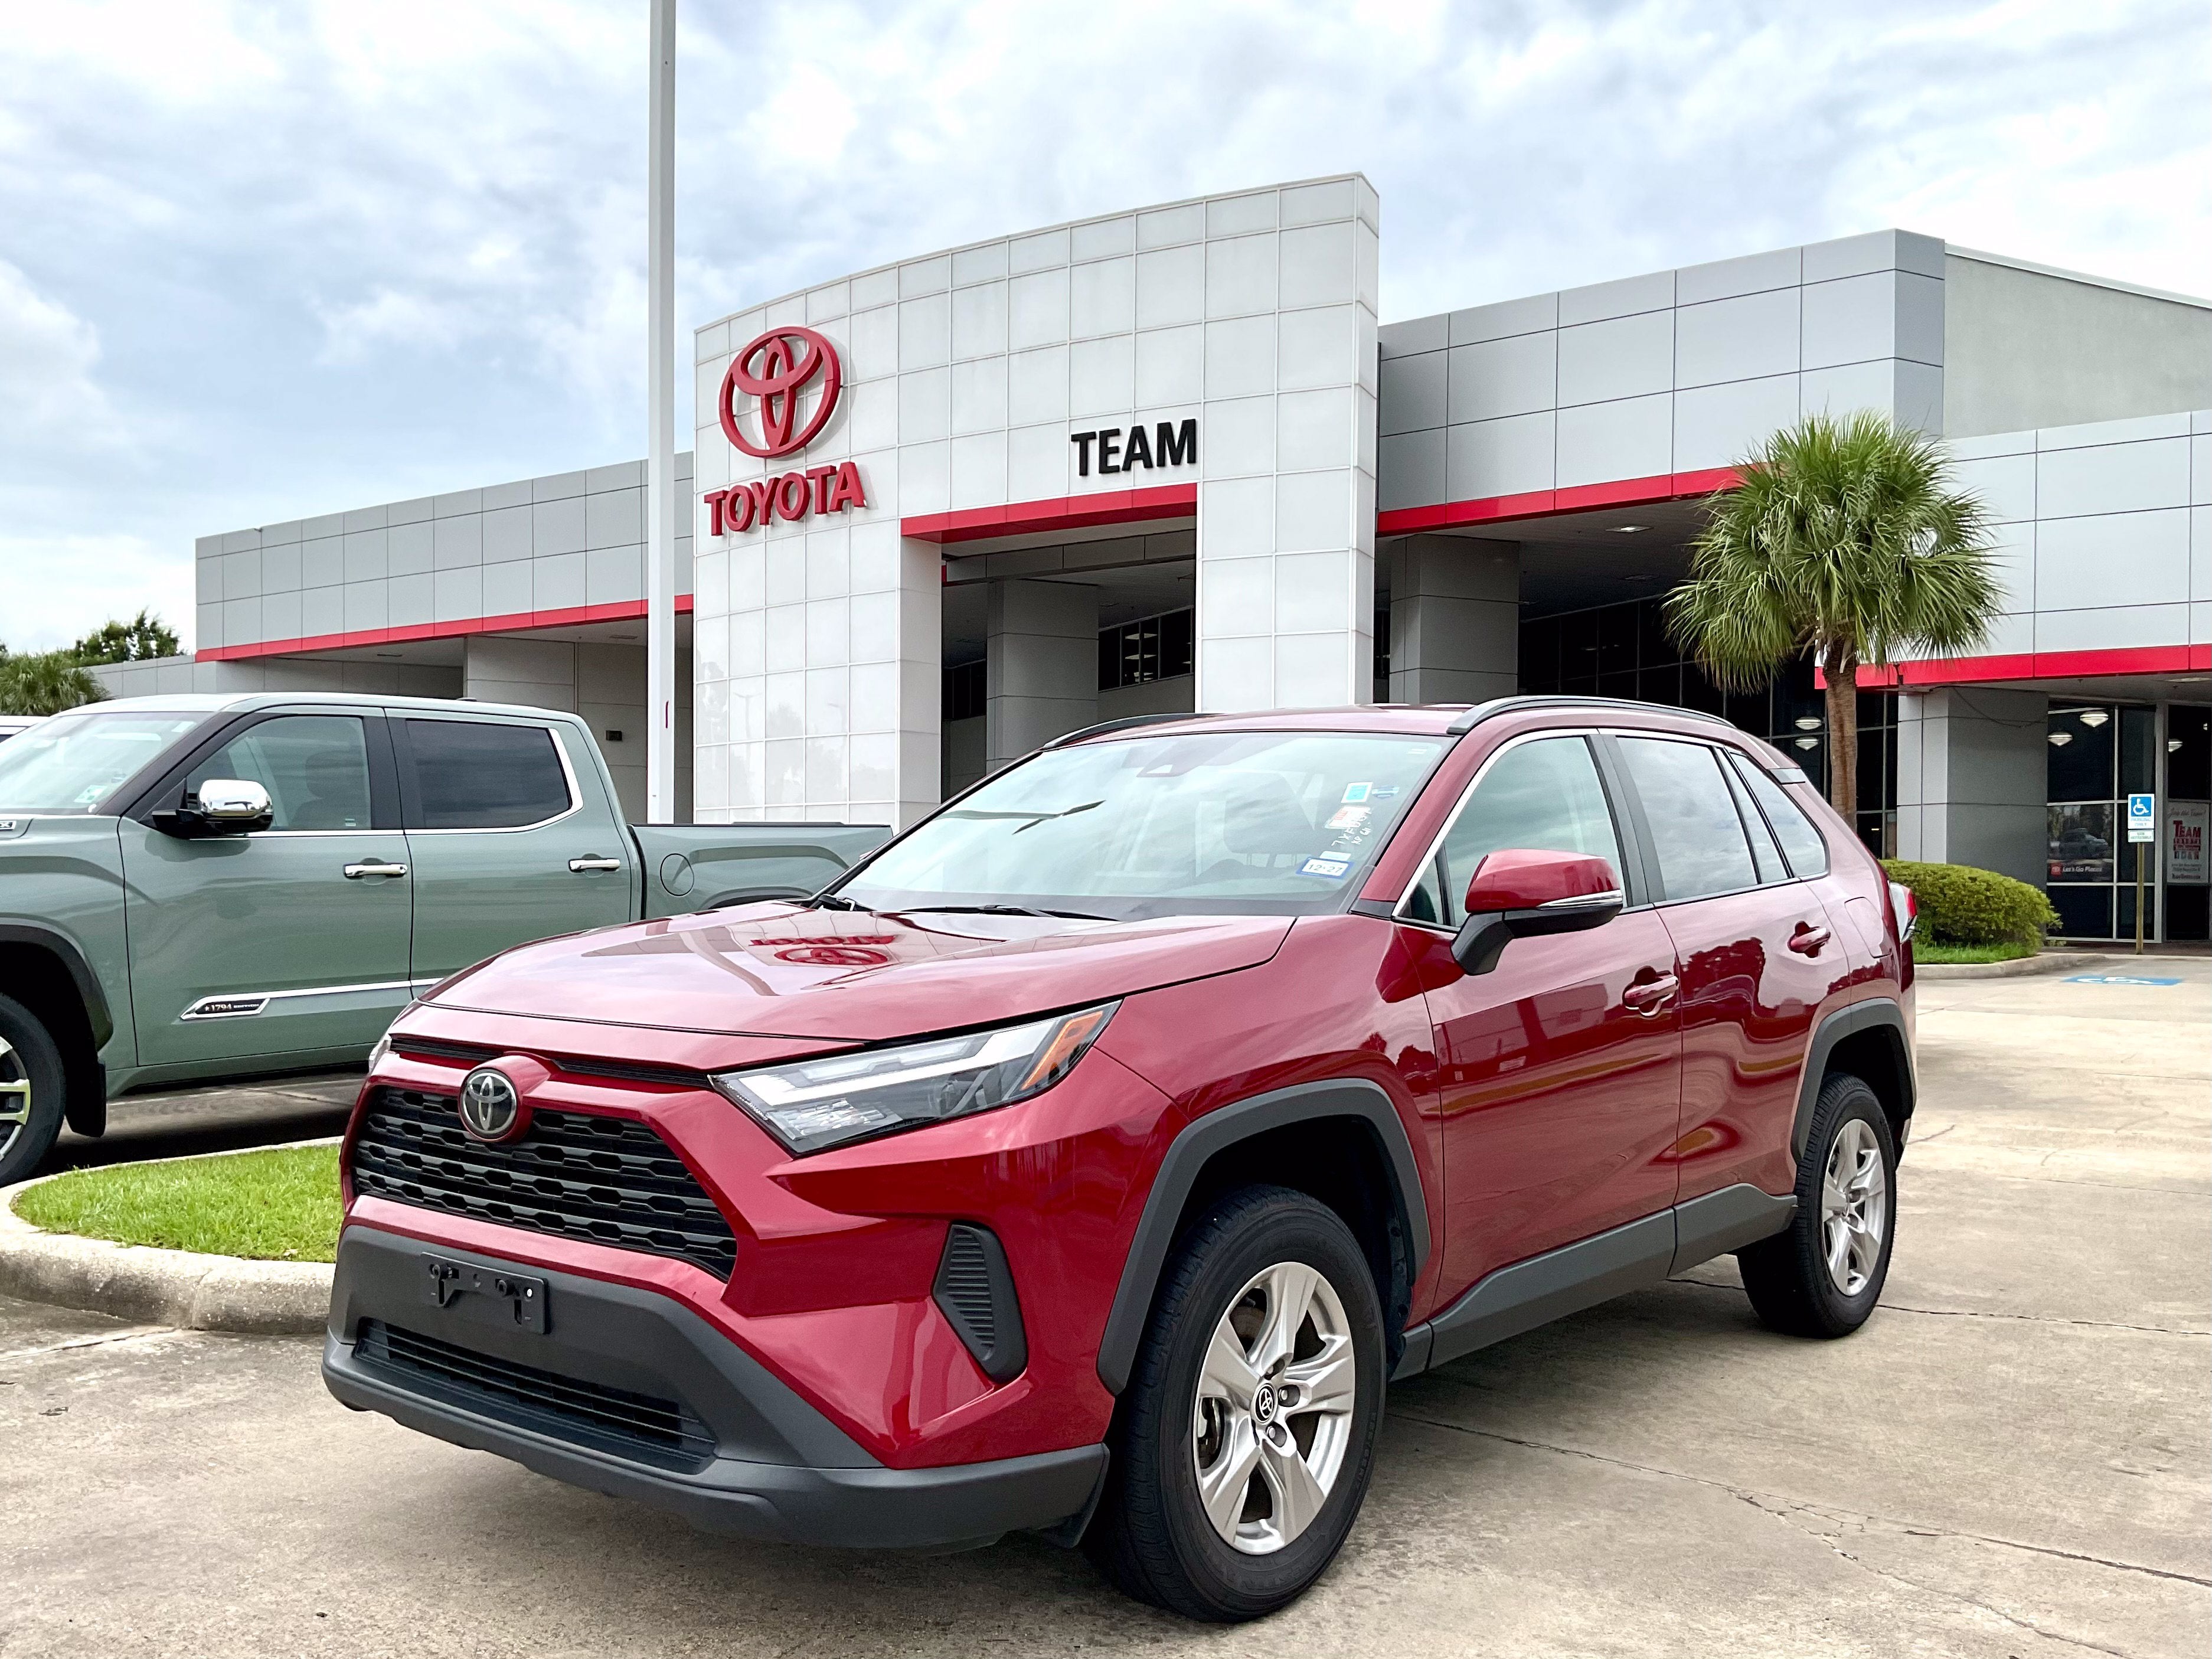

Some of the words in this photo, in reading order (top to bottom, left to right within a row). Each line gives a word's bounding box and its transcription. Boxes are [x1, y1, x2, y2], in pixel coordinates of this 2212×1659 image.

[1071, 419, 1197, 476] TEAM
[704, 462, 866, 537] TOYOTA
[2173, 820, 2201, 837] TEAM
